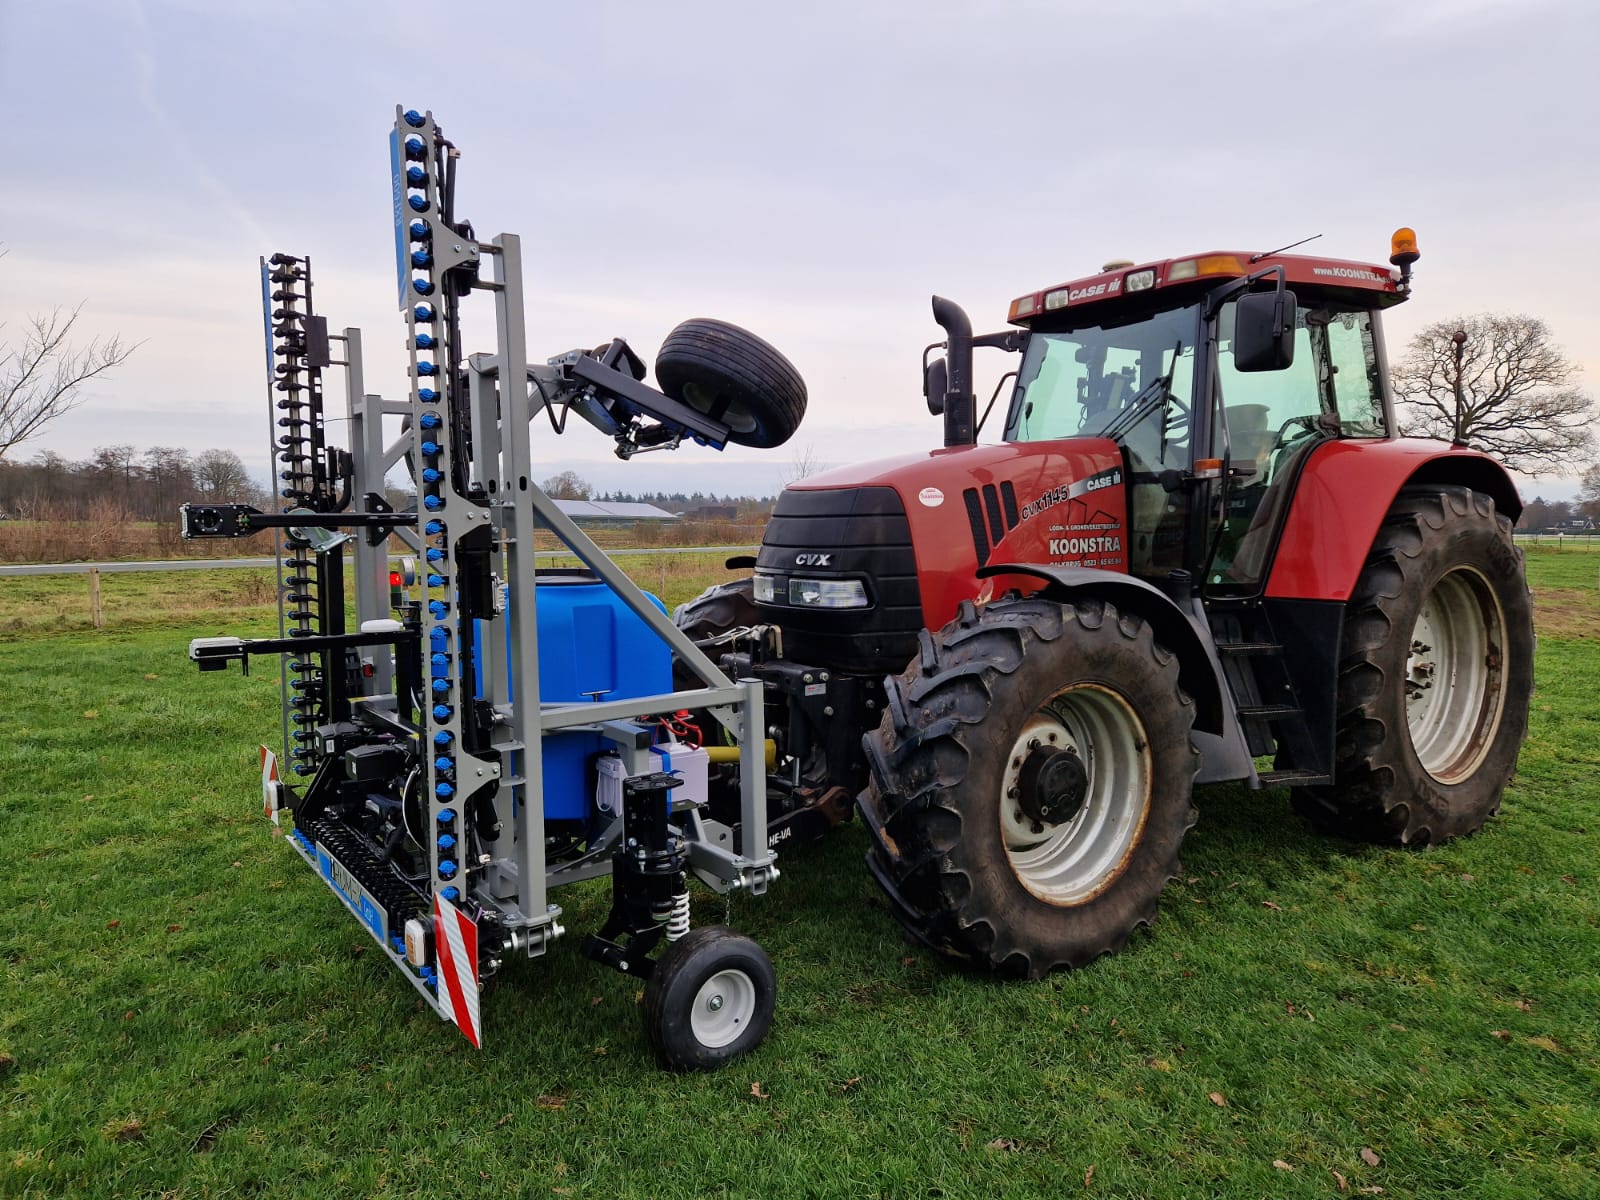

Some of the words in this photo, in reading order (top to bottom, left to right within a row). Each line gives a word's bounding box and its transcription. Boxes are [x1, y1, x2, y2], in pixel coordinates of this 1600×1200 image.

[1069, 283, 1106, 301] CASE
[1087, 476, 1112, 490] CASE
[1021, 484, 1069, 521] CVX1145
[1049, 538, 1120, 554] KOONSTRA
[795, 556, 832, 566] CVX
[768, 826, 792, 847] HE-VA
